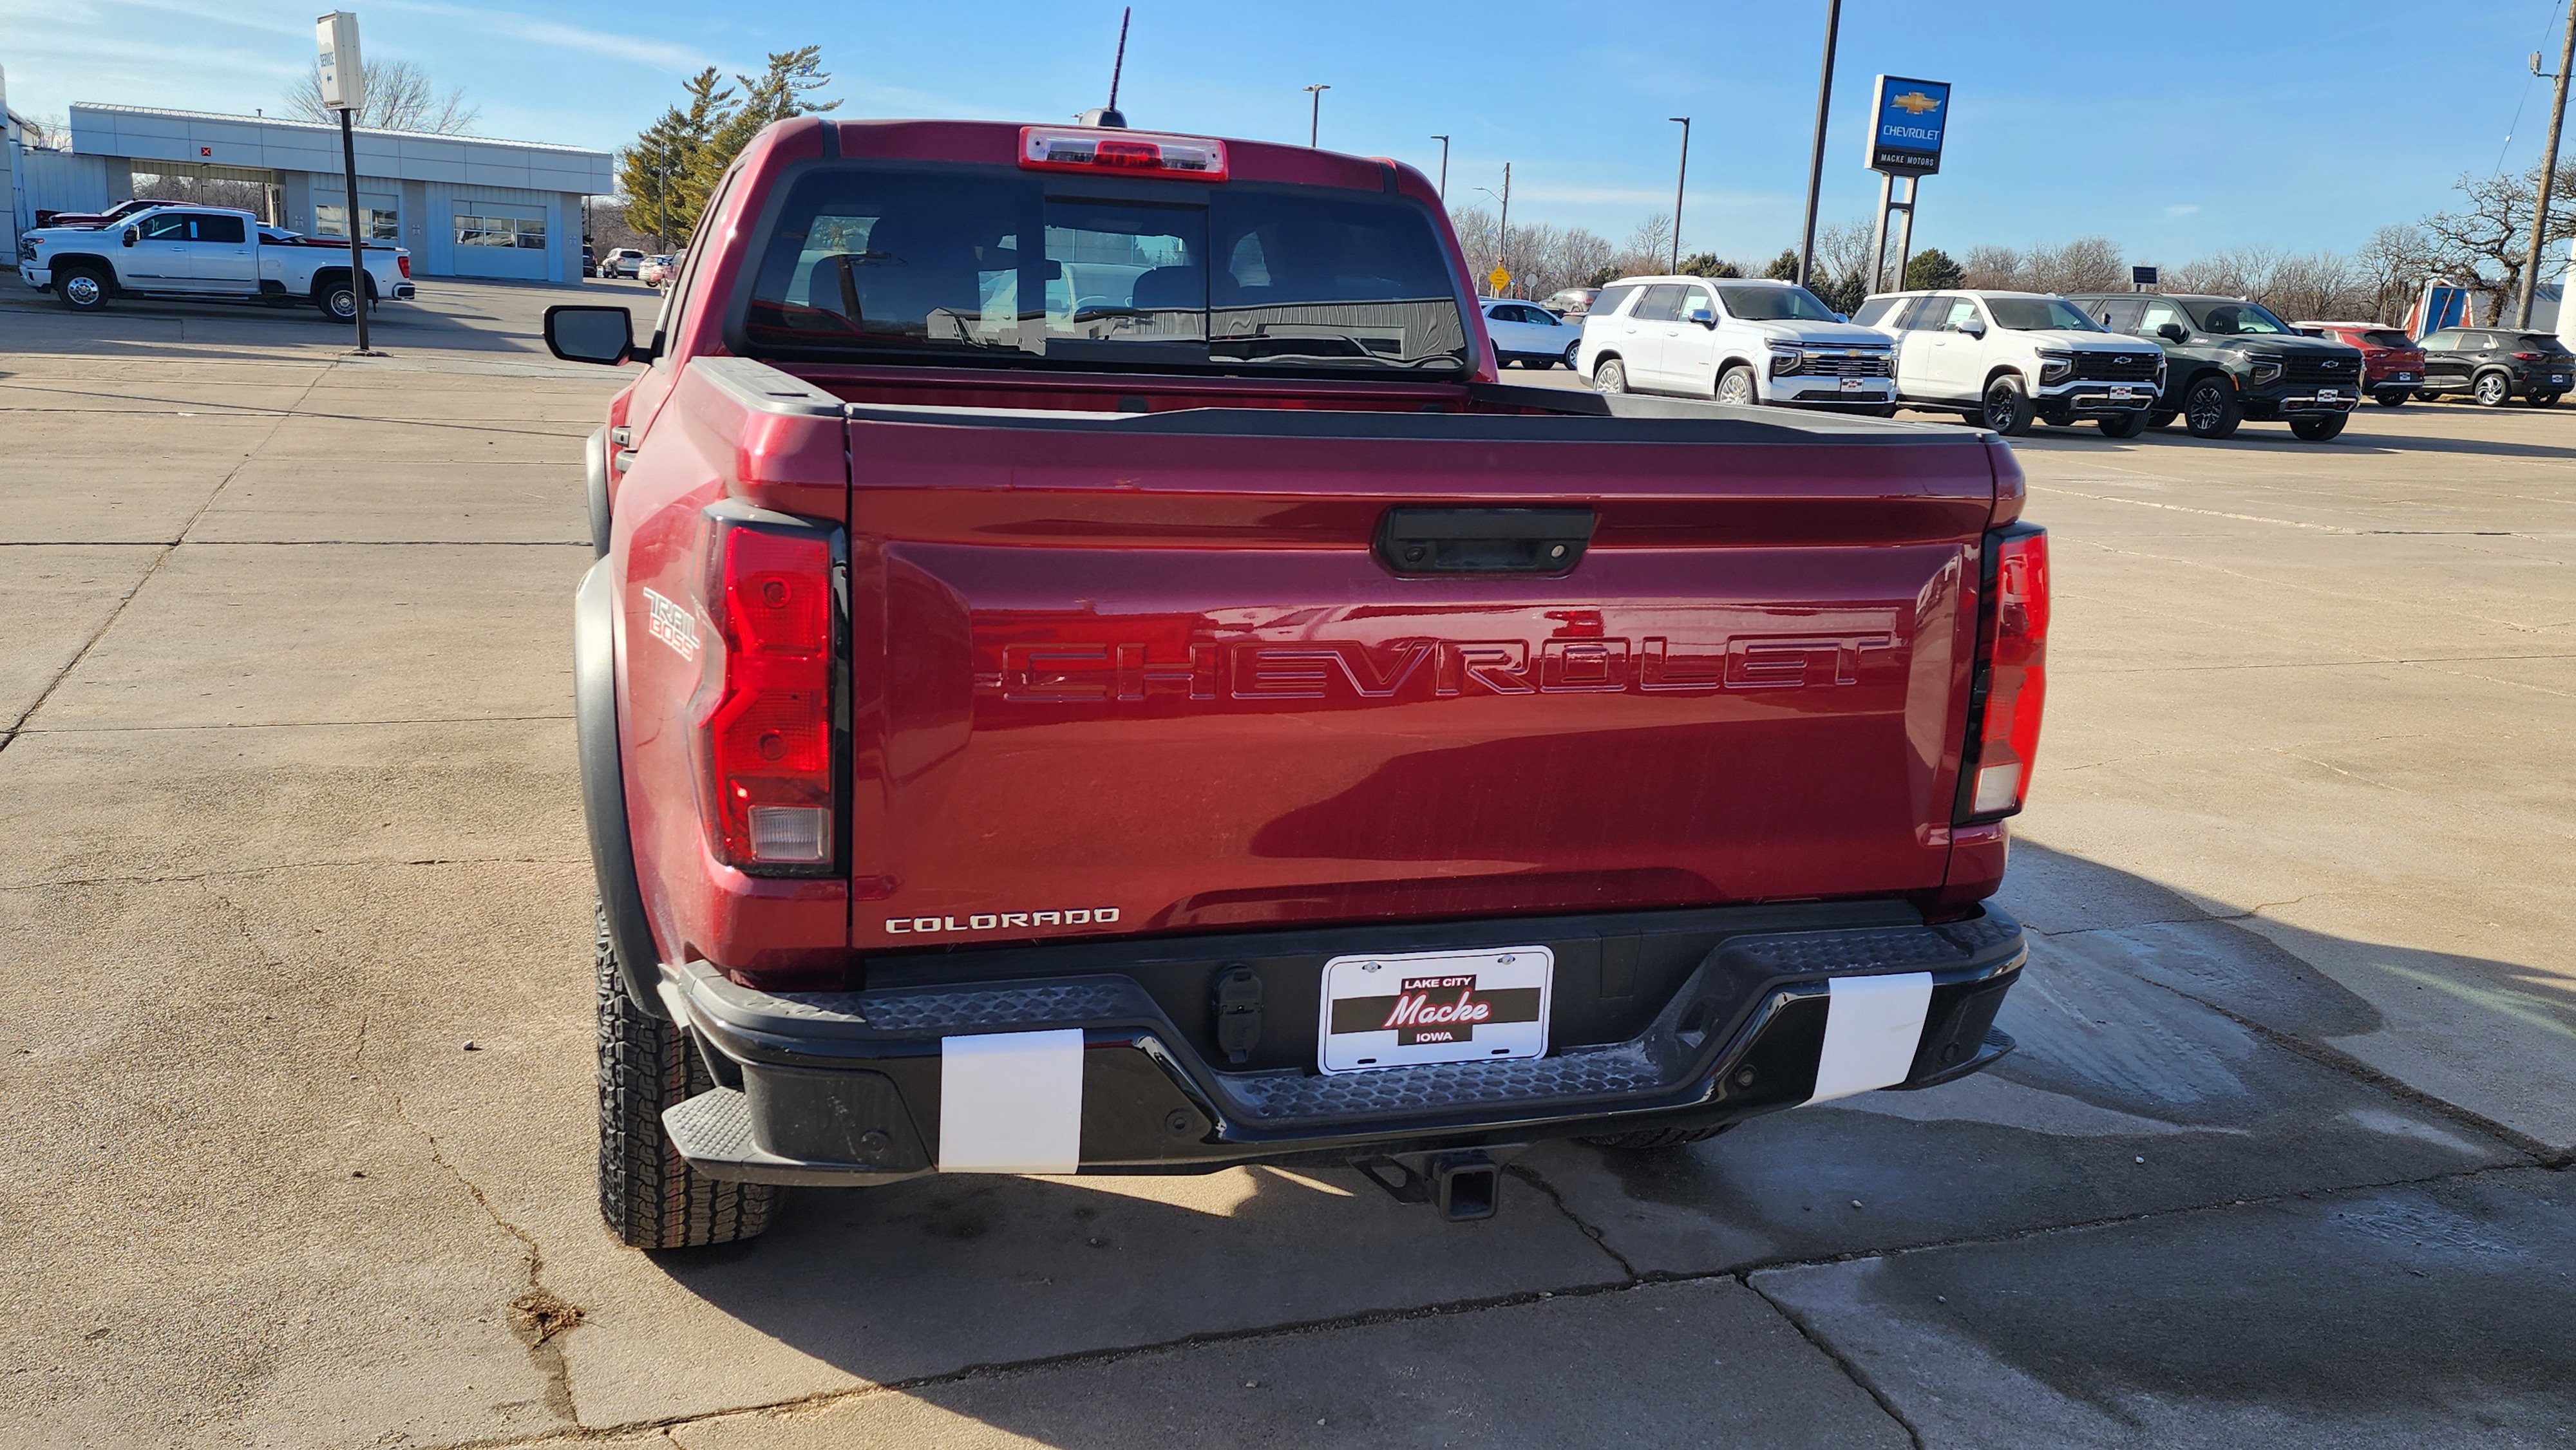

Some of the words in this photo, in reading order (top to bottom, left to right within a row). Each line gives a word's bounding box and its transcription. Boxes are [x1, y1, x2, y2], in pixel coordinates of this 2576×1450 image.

[319, 52, 334, 67] SERVICE
[1883, 125, 1940, 140] CHEVROLET
[1881, 153, 1904, 163] MACKE
[1907, 156, 1934, 165] MOTORS
[643, 587, 700, 649] TRAIL
[649, 614, 694, 662] BOSS
[1003, 631, 1892, 701] CHEVROLET
[885, 907, 1121, 934] COLORADO
[1405, 979, 1439, 989] LAKE
[1443, 977, 1472, 987] CITY
[1383, 990, 1490, 1028] Macke
[1416, 1032, 1453, 1042] IOWA
